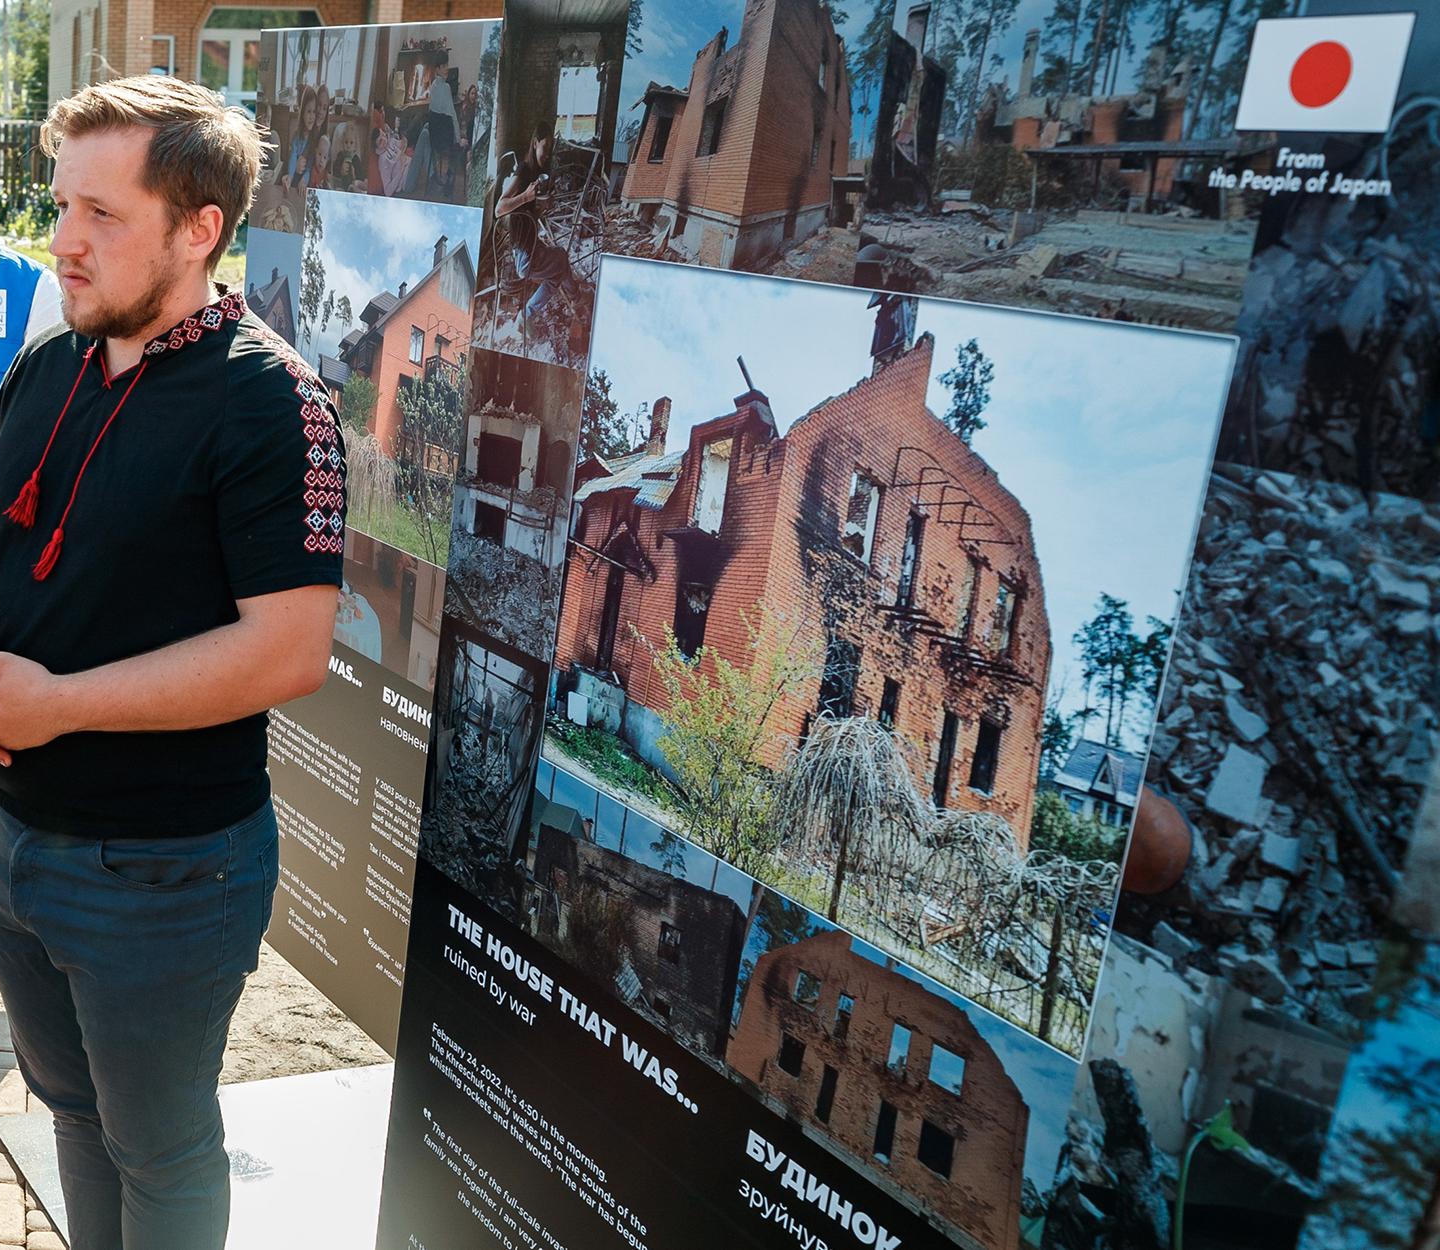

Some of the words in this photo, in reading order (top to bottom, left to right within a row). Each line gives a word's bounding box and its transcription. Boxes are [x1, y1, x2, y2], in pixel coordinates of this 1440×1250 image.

[1208, 167, 1236, 188] the
[1240, 170, 1301, 195] People
[1305, 171, 1330, 193] of
[1329, 173, 1392, 200] Japan
[1277, 148, 1325, 168] From
[301, 738, 315, 753] house
[350, 769, 360, 784] and
[335, 785, 353, 802] picture
[380, 780, 395, 796] 2003
[304, 817, 318, 833] home
[444, 945, 487, 988] ruined
[489, 976, 507, 1005] by
[509, 995, 536, 1026] war
[449, 903, 483, 948] THE
[486, 933, 554, 1002] HOUSE
[558, 986, 617, 1047] THAT
[622, 1033, 698, 1114] WAS...
[429, 1053, 462, 1089] whistling
[463, 1084, 492, 1115] rockets
[493, 1111, 509, 1130] and
[510, 1125, 524, 1144] the
[525, 1140, 553, 1173] words,
[579, 1187, 596, 1208] war
[598, 1204, 614, 1226] has
[431, 1036, 445, 1056] The
[445, 1050, 485, 1092] Khreschuk
[486, 1086, 511, 1116] family
[512, 1111, 538, 1139] wakes
[540, 1135, 552, 1151] up
[553, 1145, 563, 1161] to
[565, 1156, 580, 1176] the
[581, 1173, 615, 1208] sounds
[617, 1205, 629, 1219] of
[630, 1214, 647, 1236] the
[432, 1022, 466, 1059] February
[466, 1052, 479, 1072] 24,
[480, 1064, 503, 1091] 2022.
[504, 1085, 517, 1103] It's
[518, 1099, 538, 1121] 4:50
[540, 1115, 548, 1131] in
[550, 1125, 565, 1145] the
[566, 1141, 607, 1183] morning.
[423, 1134, 447, 1161] family
[447, 1157, 462, 1176] was
[463, 1172, 497, 1211] together.
[498, 1207, 503, 1216] I
[503, 1213, 517, 1230] am
[518, 1227, 537, 1249] very
[432, 1121, 445, 1140] The
[446, 1136, 462, 1156] first
[462, 1153, 477, 1171] day
[478, 1168, 488, 1180] of
[488, 1176, 501, 1195] the
[503, 1190, 539, 1232] full-scale
[738, 1179, 830, 1250] зруйнув
[745, 1128, 902, 1250] БУДИНОК
[457, 1190, 470, 1208] the
[472, 1205, 502, 1240] wisdom
[503, 1236, 512, 1250] to
